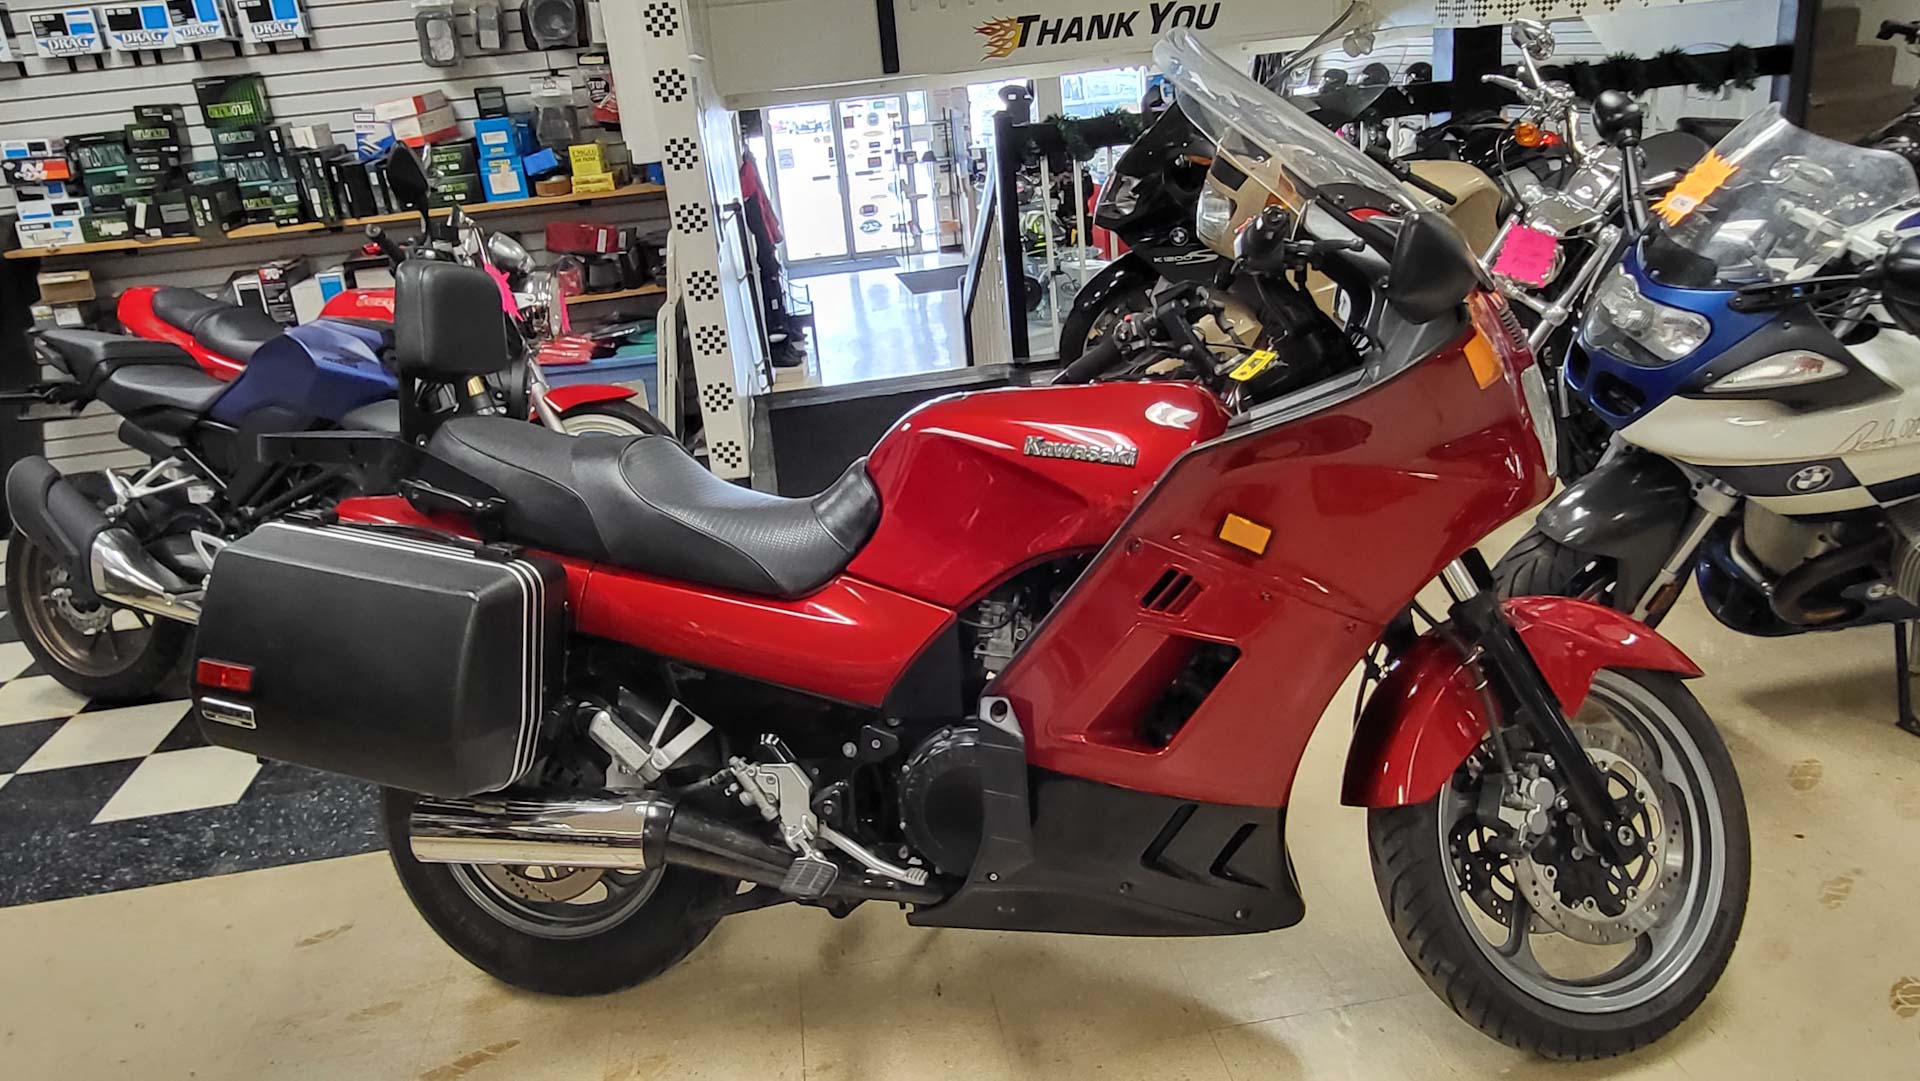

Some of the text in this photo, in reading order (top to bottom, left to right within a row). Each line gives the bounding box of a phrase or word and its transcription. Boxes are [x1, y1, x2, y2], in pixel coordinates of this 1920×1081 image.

[121, 28, 163, 43] DRAG
[182, 24, 215, 37] DRAG
[253, 20, 292, 36] DRAG
[47, 37, 90, 51] DRAG
[1023, 435, 1140, 467] Kawasaki
